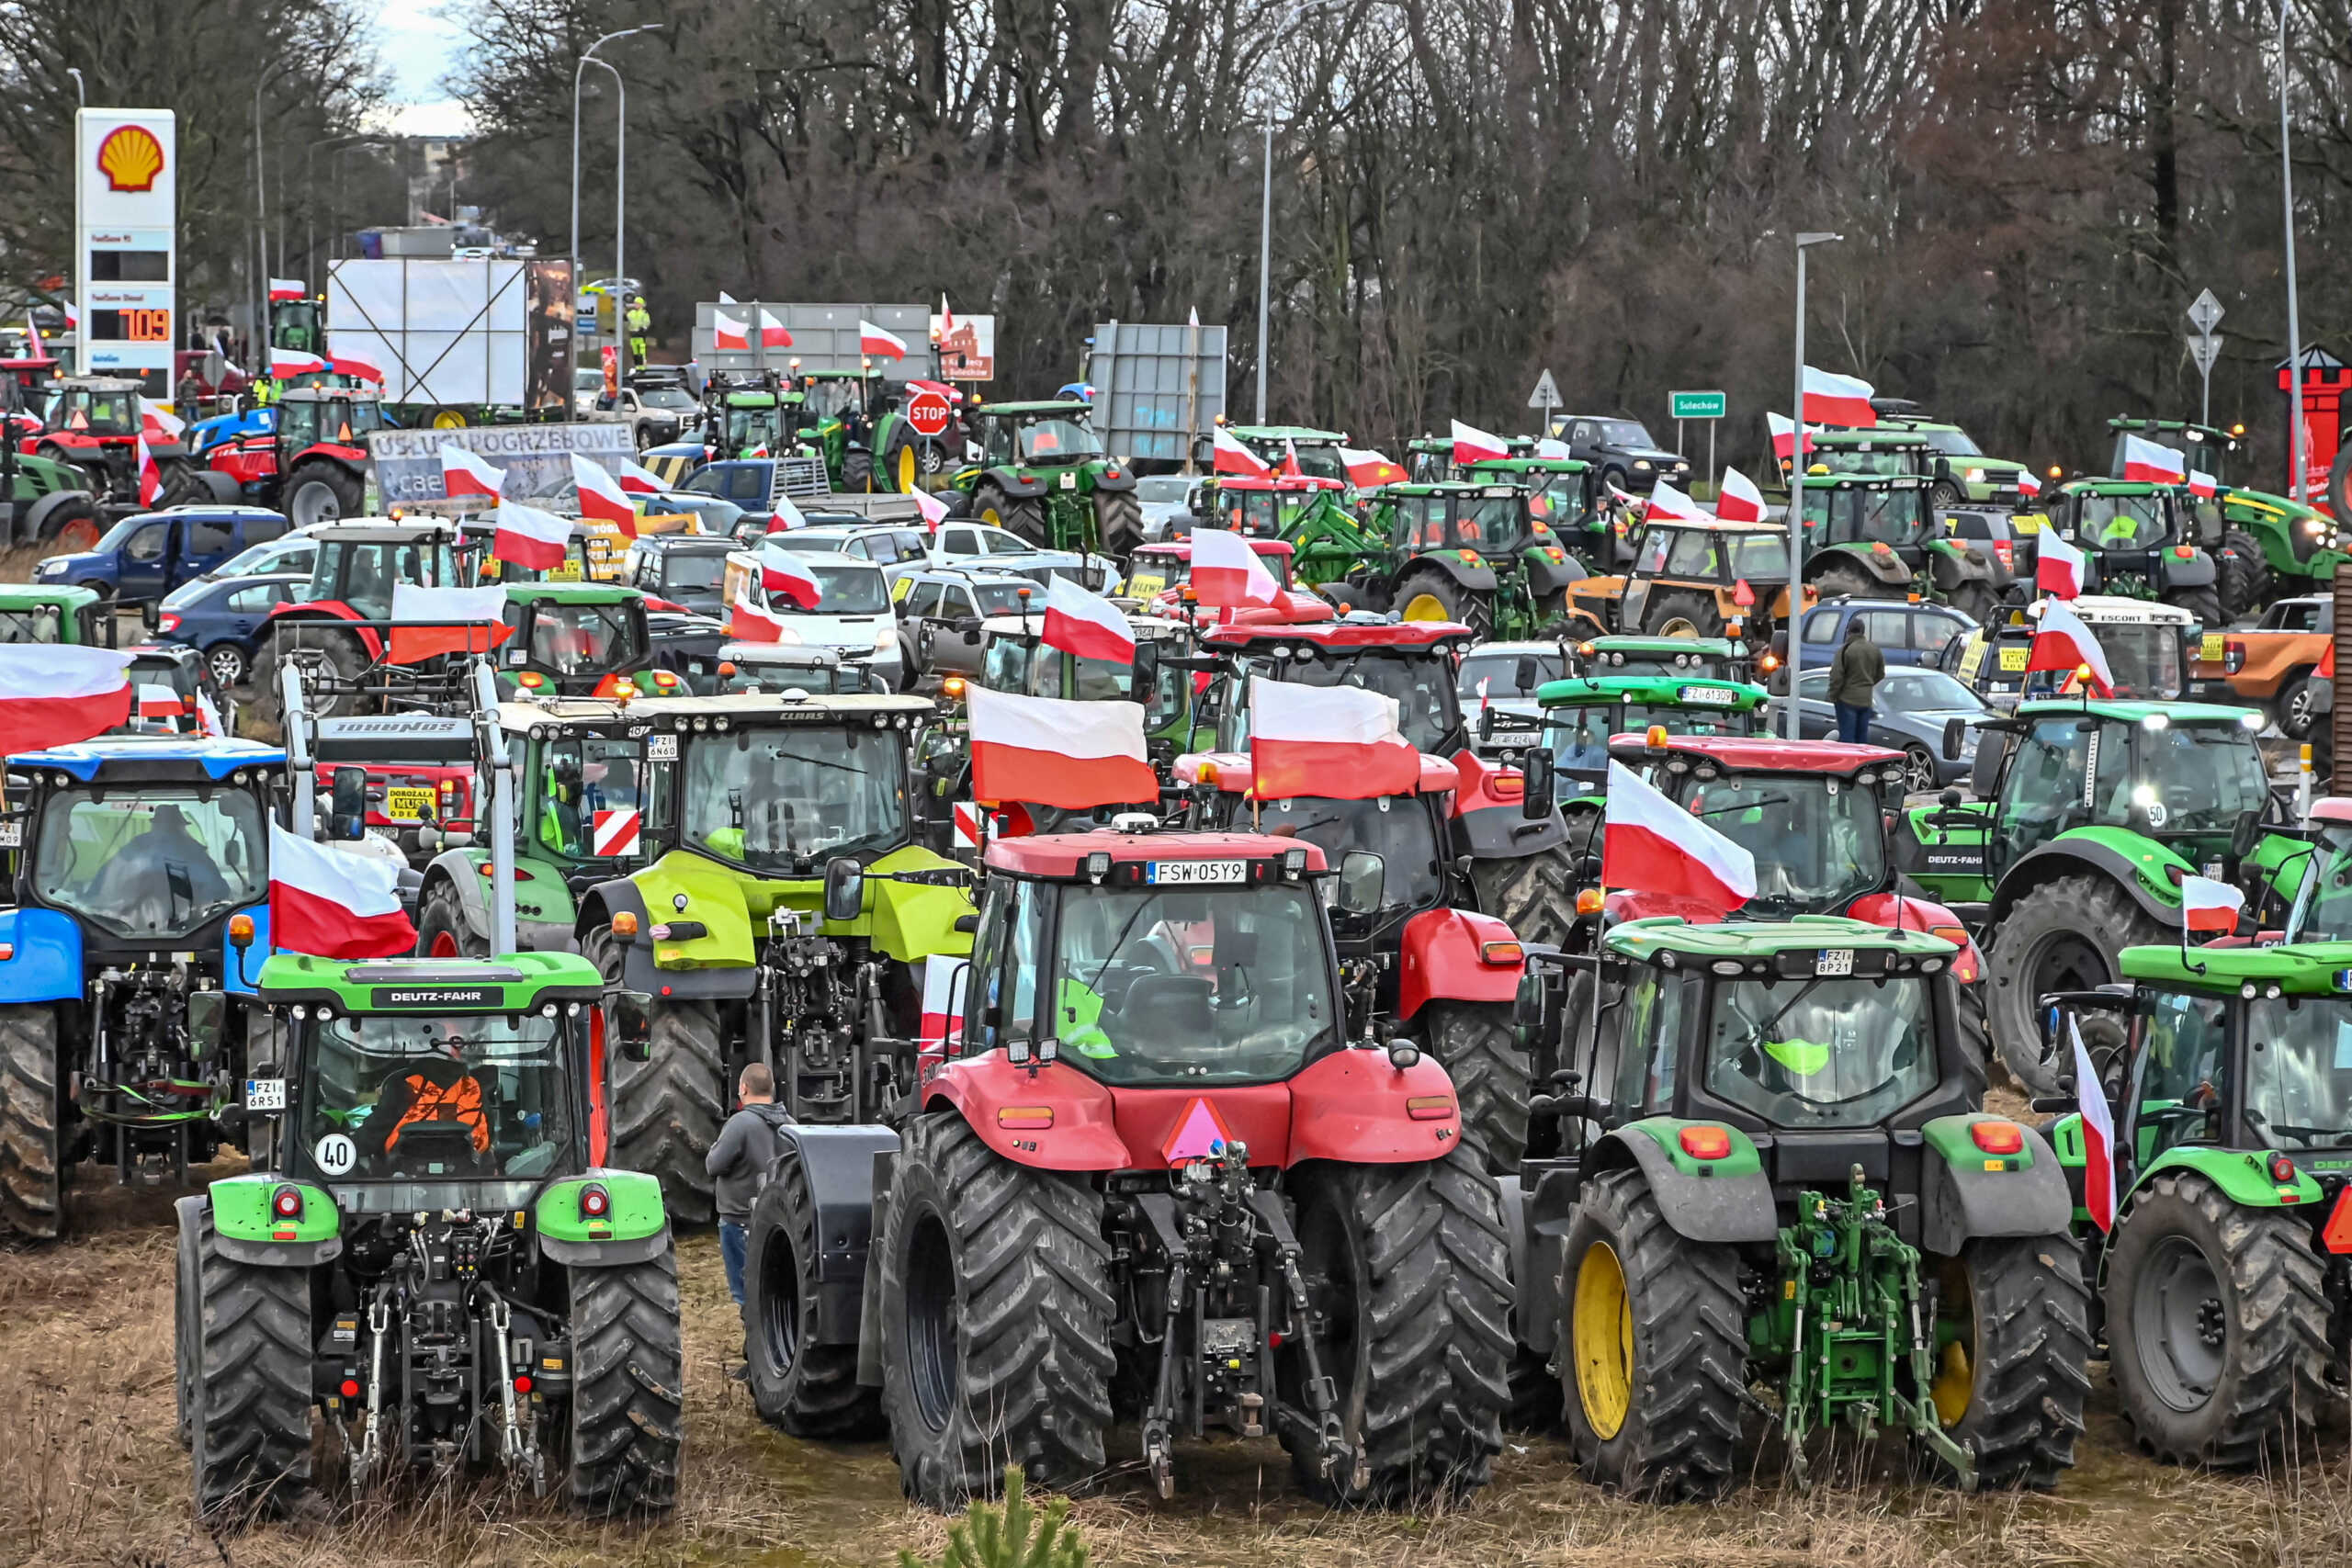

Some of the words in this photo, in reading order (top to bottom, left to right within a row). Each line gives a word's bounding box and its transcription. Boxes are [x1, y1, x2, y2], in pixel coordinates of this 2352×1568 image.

[1679, 400, 1719, 411] Sulechów
[912, 407, 947, 421] STOP
[469, 428, 632, 456] POGRZEBOWE
[401, 473, 442, 492] cae
[1705, 690, 1731, 700] 61309
[779, 712, 825, 720] CLAAS
[655, 737, 672, 745] FZI
[650, 747, 675, 756] 6N60
[2149, 806, 2163, 821] 50
[1159, 863, 1194, 881] FSW
[1198, 863, 1241, 881] 05Y9
[1826, 951, 1846, 962] FZI
[1819, 964, 1849, 972] 8P21
[390, 992, 481, 1001] DEUTZ-FAHR
[256, 1082, 277, 1093] FZI
[323, 1142, 347, 1167] 40
